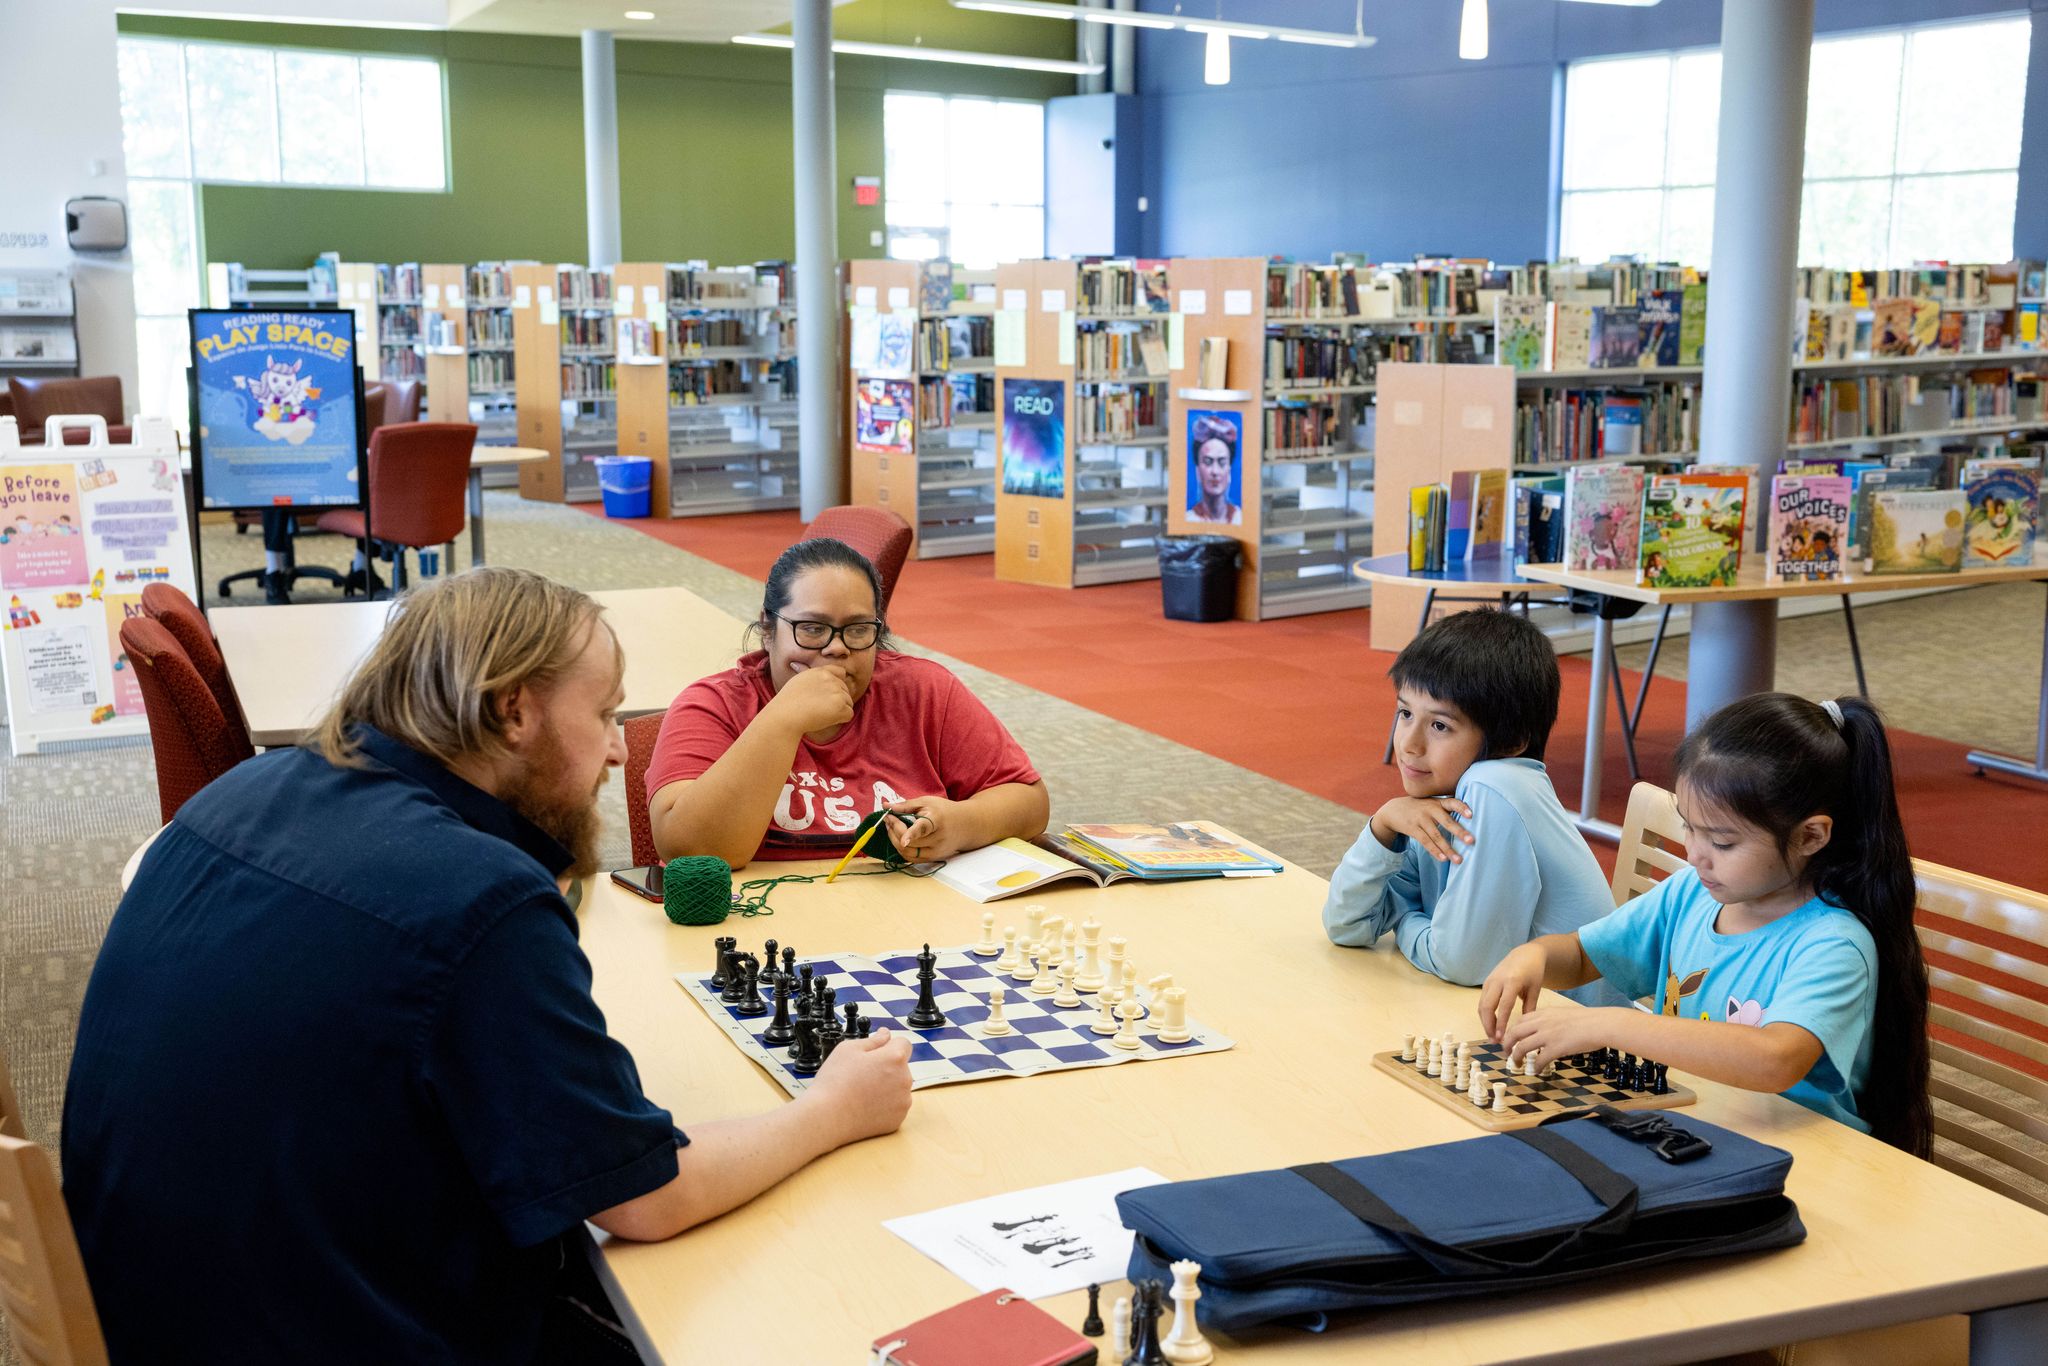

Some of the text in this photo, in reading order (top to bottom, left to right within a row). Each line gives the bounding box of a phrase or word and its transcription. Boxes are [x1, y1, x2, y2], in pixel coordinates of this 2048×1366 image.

[223, 312, 325, 330] READING READY
[197, 324, 350, 359] PLAY SPACE
[1014, 395, 1054, 416] READ
[4, 474, 61, 493] Before
[0, 489, 70, 508] you leave
[1780, 488, 1809, 511] OUR
[1795, 499, 1846, 522] VOICES
[1777, 560, 1840, 574] TOGETHER
[789, 770, 845, 792] xas
